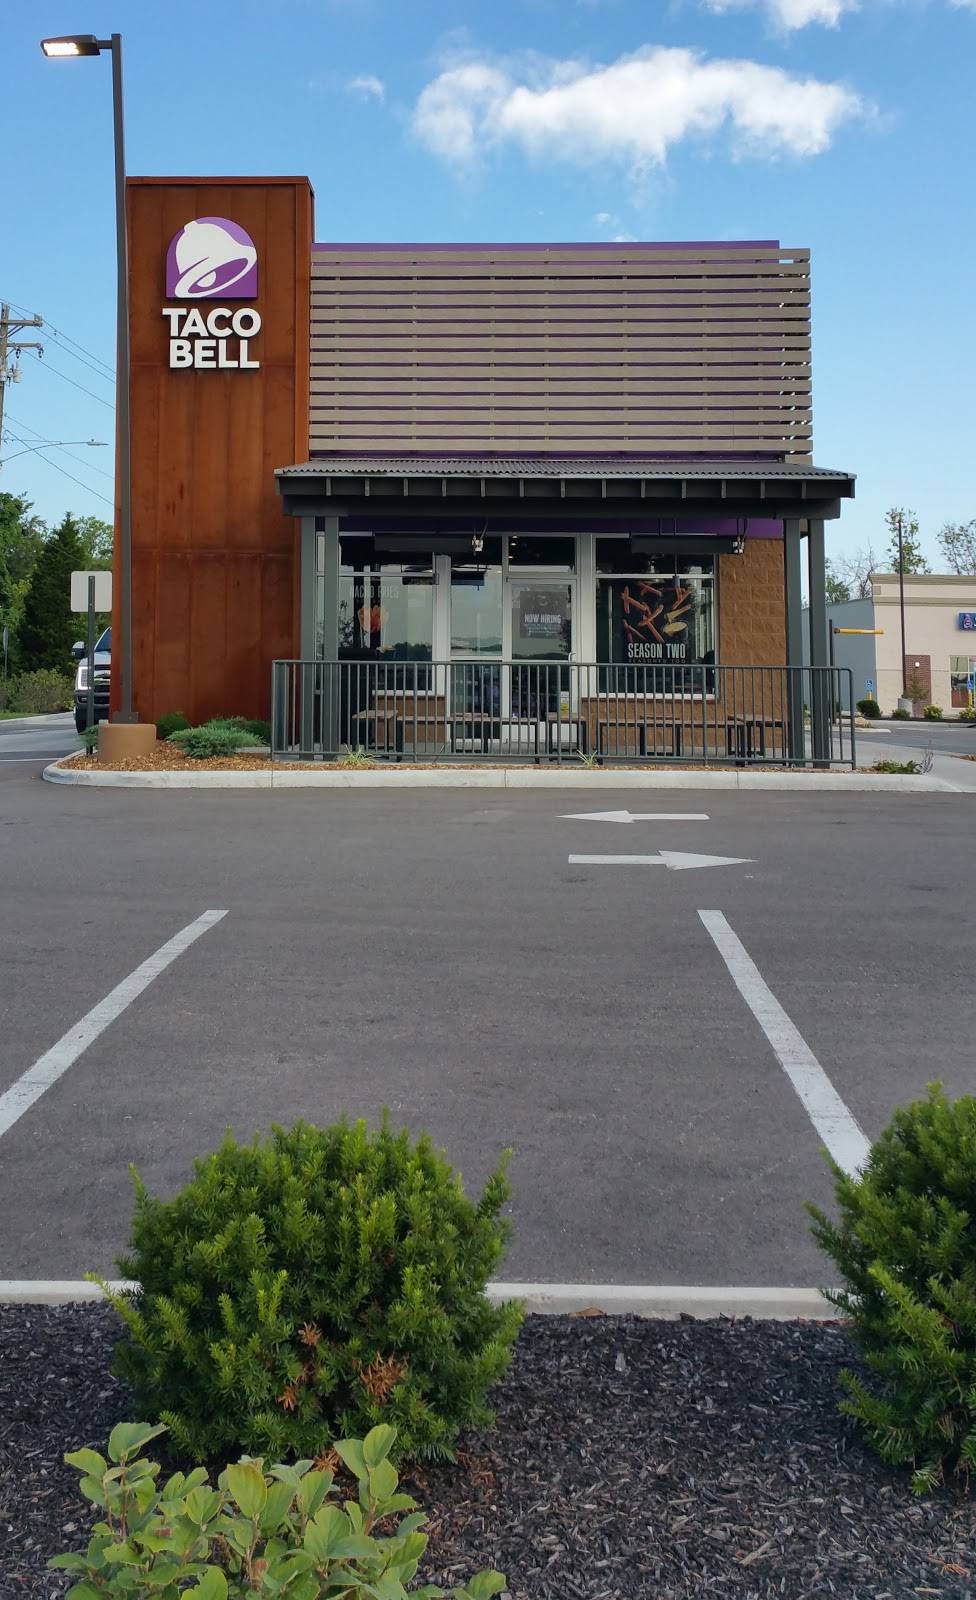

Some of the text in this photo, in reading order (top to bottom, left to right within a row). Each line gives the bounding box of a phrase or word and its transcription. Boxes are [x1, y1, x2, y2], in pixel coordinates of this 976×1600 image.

[162, 308, 261, 337] TACO
[169, 339, 260, 368] BELL
[524, 612, 562, 624] NOW HIRING
[627, 642, 686, 659] SEASON TWO
